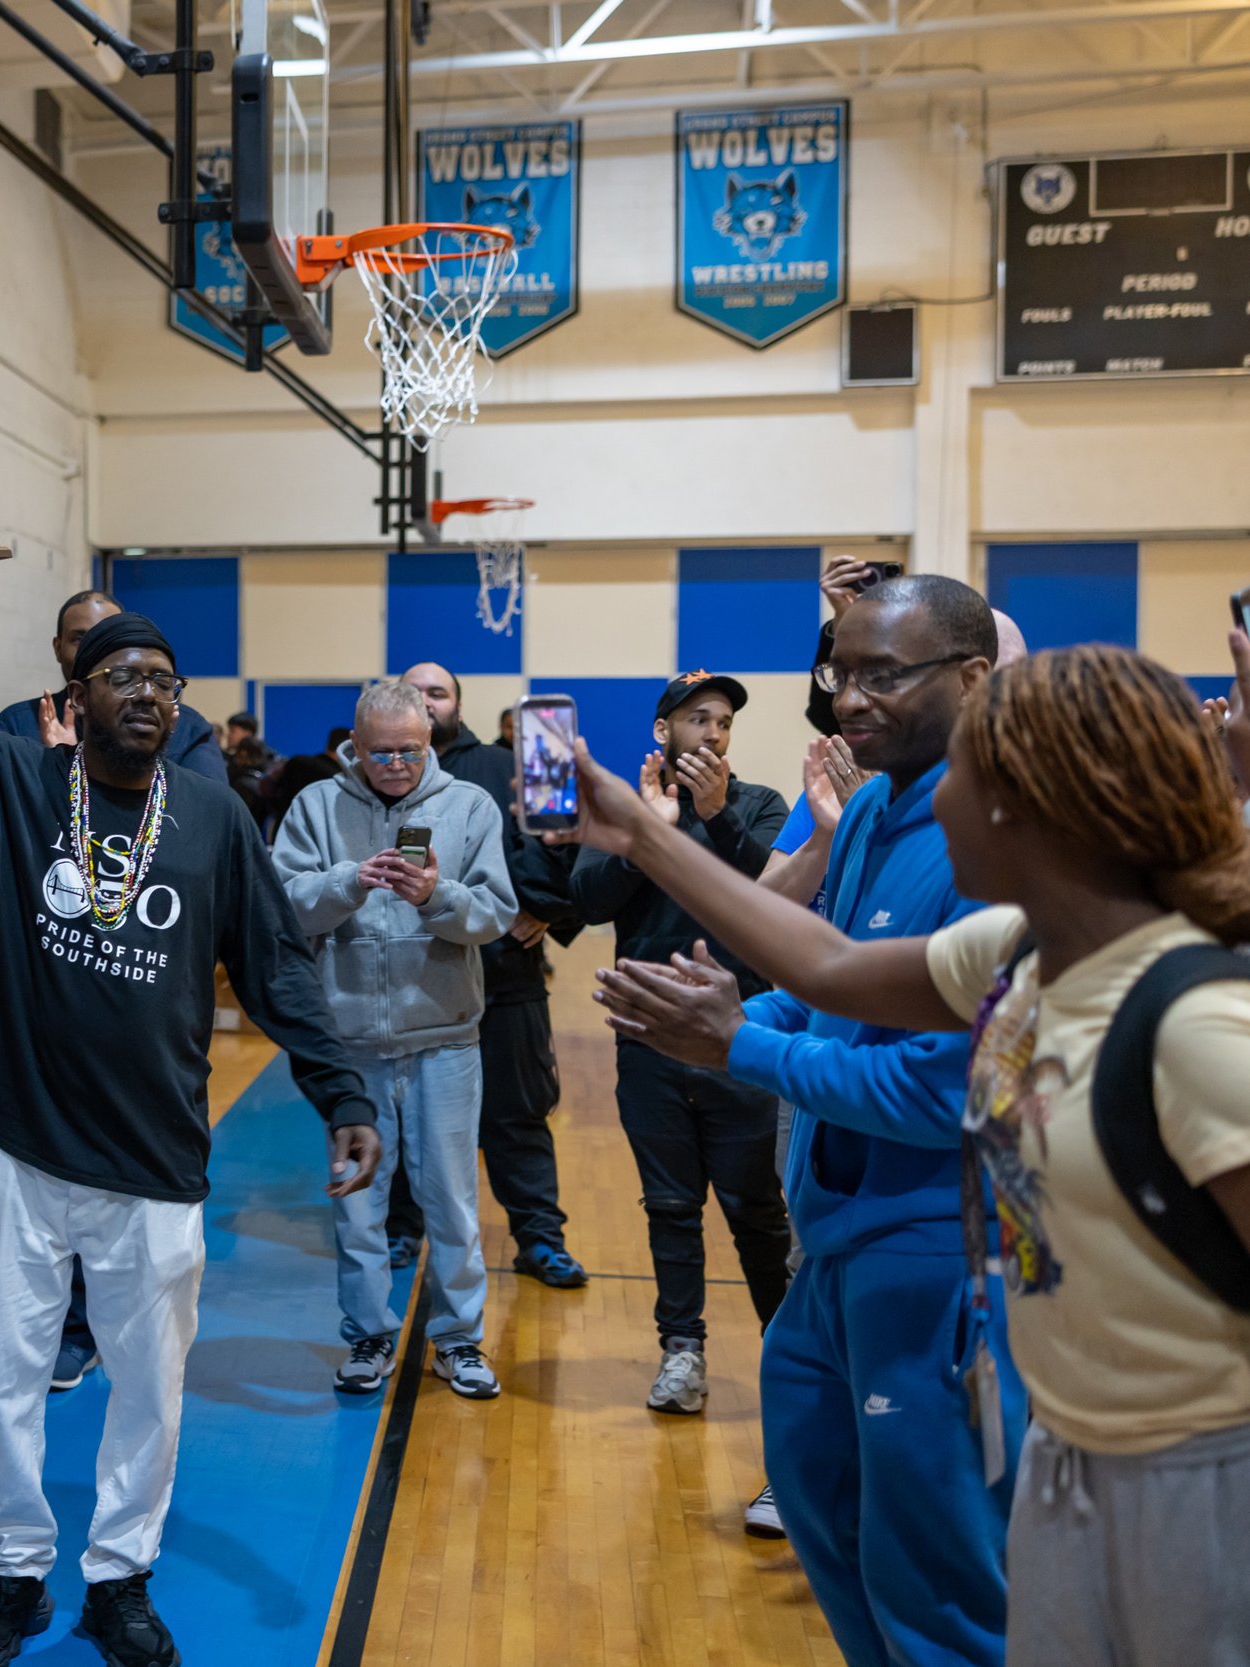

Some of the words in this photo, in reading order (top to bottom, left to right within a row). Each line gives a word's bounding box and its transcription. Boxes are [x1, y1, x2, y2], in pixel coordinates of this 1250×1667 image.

[427, 140, 569, 183] WOLVES
[688, 125, 838, 170] WOLVES
[1026, 222, 1112, 247] GUEST
[1215, 215, 1250, 238] HO
[692, 261, 829, 284] WRESTLING
[1121, 272, 1198, 293] PERIOD
[1103, 302, 1212, 321] PLAYER-FOUL
[36, 913, 94, 948] PRIDE
[101, 940, 126, 957] OF
[134, 948, 168, 967] THE
[41, 936, 157, 983] SOUTHSIDE
